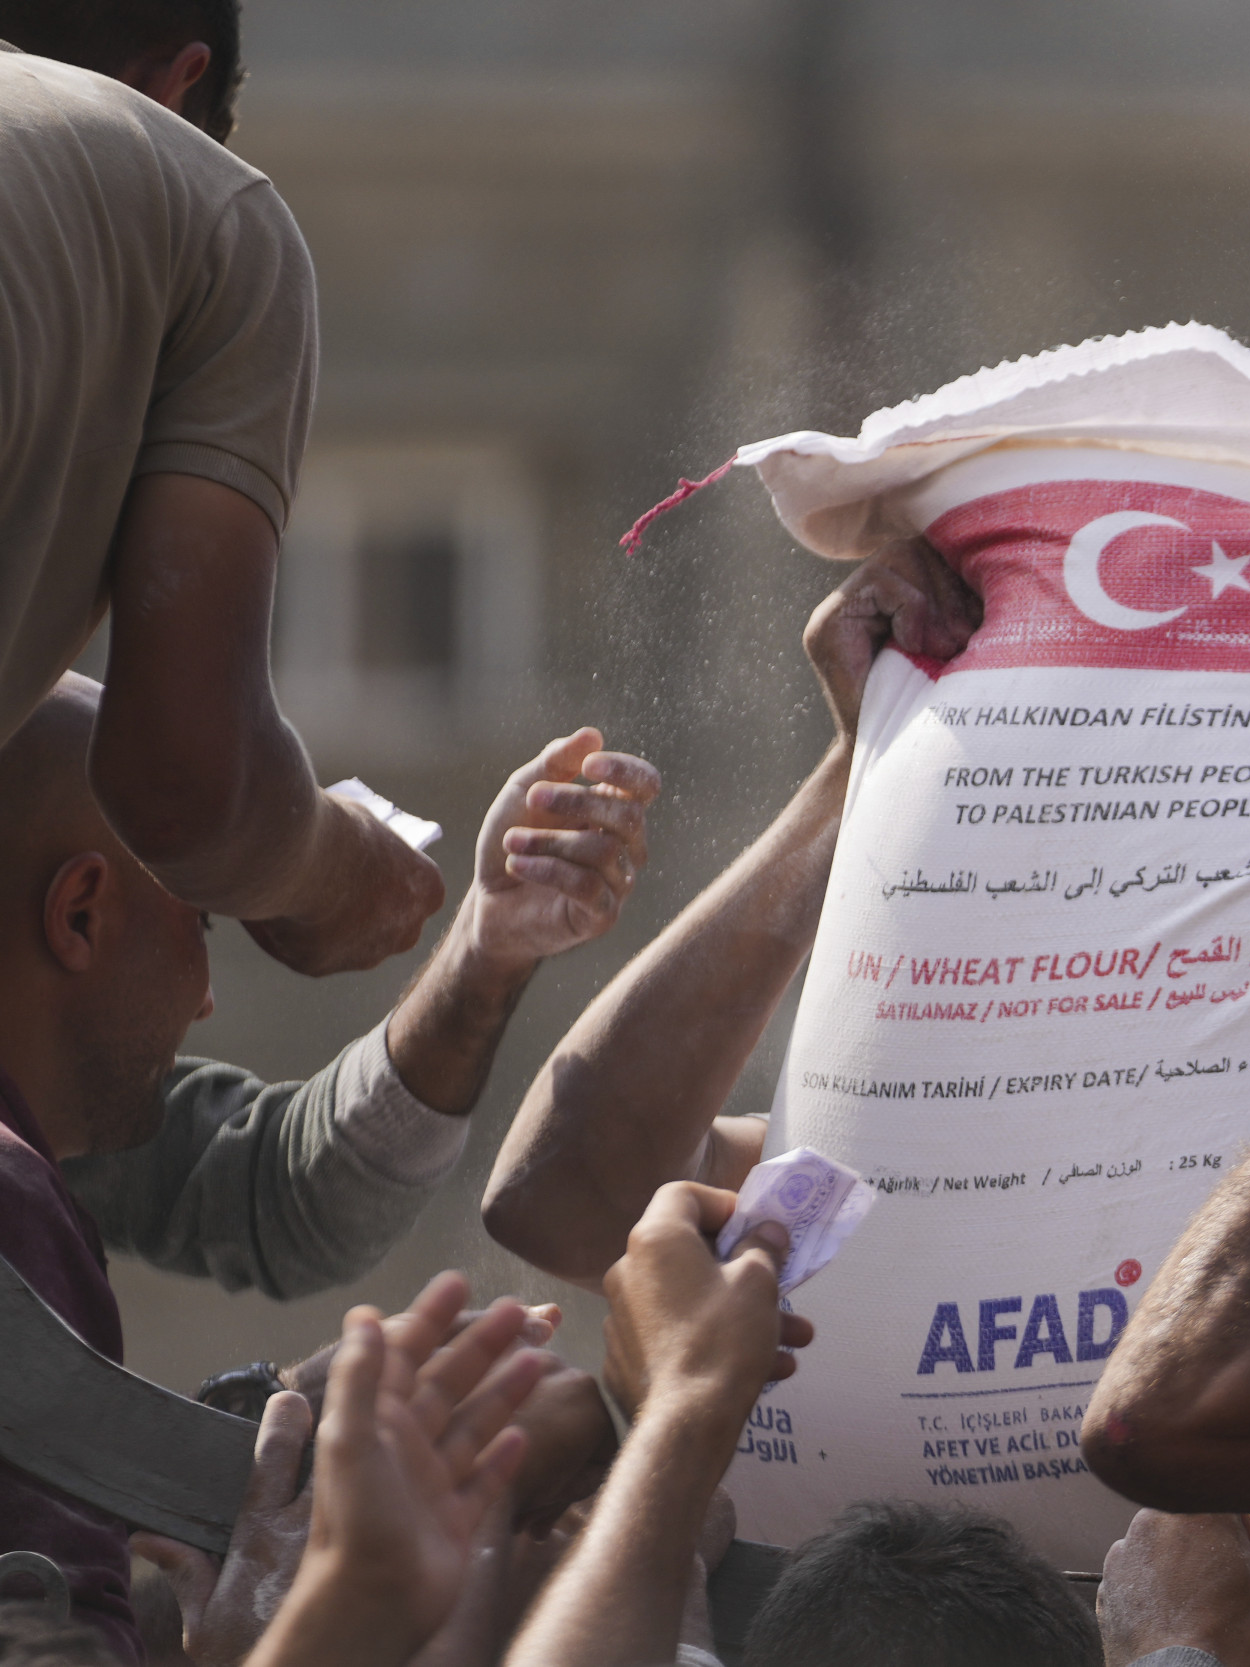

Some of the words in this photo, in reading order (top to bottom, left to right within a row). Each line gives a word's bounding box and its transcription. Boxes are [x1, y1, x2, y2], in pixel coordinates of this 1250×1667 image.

[974, 705, 1133, 727] HALKINDAN
[944, 766, 1013, 787] FROM
[1022, 766, 1070, 787] THE
[1078, 765, 1193, 785] TURKISH
[956, 804, 986, 825] TO
[991, 801, 1160, 825] PALESTINIAN
[882, 868, 978, 900] الفلسطيني
[985, 868, 1058, 899] الشعب
[1064, 865, 1104, 900] إلى
[1109, 862, 1187, 897] التركي
[848, 950, 883, 982] UN
[911, 957, 1024, 986] WHEAT
[1167, 936, 1242, 978] القمح
[875, 1001, 978, 1021] SATILAMAZ
[997, 1000, 1043, 1018] NOT
[1047, 996, 1088, 1014] FOR
[1093, 991, 1143, 1012] SALE
[1165, 983, 1207, 1010] للبيع
[801, 1071, 828, 1090] SON
[832, 1075, 916, 1099] KULLANIM
[922, 1076, 985, 1098] TARİHİ
[1006, 1072, 1077, 1095] EXPIRY
[1155, 1057, 1231, 1082] الصلاحية
[1058, 1163, 1102, 1185] الصافي
[1106, 1159, 1142, 1178] الوزن
[1178, 1155, 1197, 1170] 25
[1202, 1153, 1222, 1169] Kg
[943, 1175, 969, 1191] Net
[974, 1172, 1026, 1190] Weight
[917, 1287, 1129, 1375] AFAD
[918, 1415, 948, 1431] T.C.
[961, 1407, 1027, 1433] İÇİŞLERİ
[1041, 1404, 1088, 1422] BAKA
[923, 1439, 970, 1459] AFET
[975, 1437, 999, 1457] VE
[1007, 1430, 1051, 1453] ACİL
[926, 1461, 1020, 1486] YÖNETİMİ
